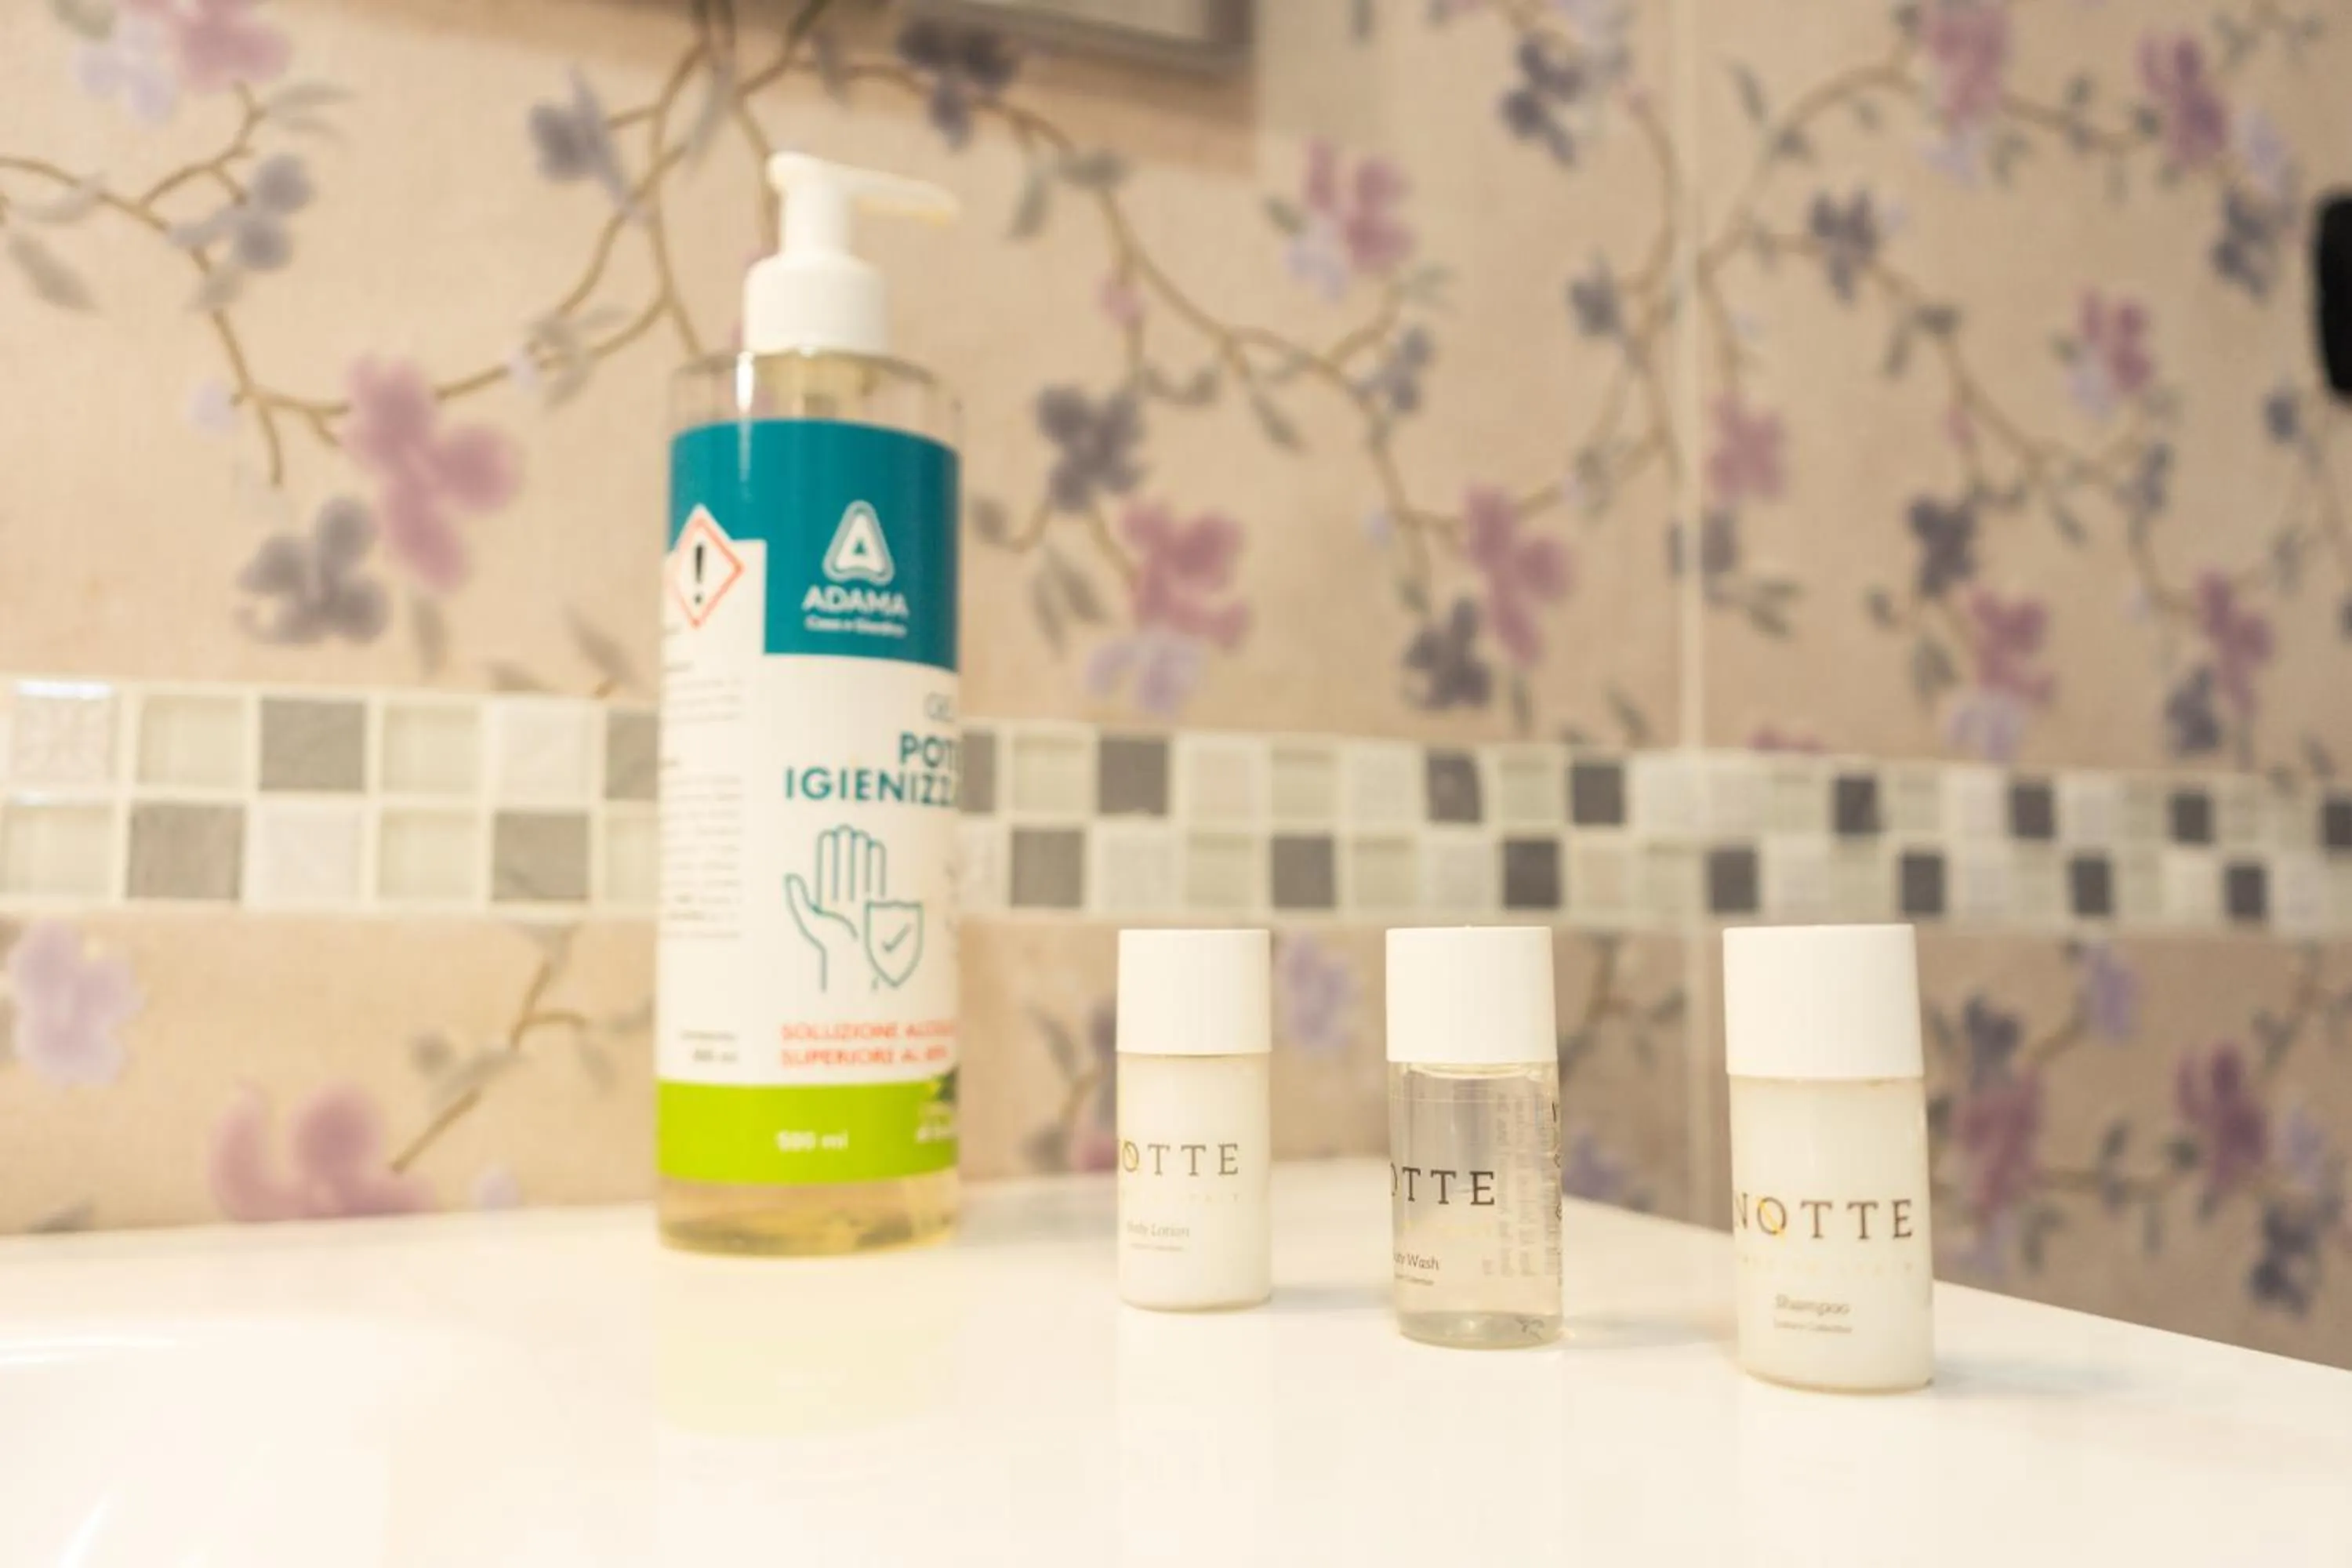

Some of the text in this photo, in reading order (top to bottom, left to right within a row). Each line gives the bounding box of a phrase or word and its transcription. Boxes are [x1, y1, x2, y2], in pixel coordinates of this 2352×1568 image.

[801, 585, 909, 617] ADAMA
[1733, 1191, 1913, 1240] NOTTE
[1406, 1253, 1439, 1271] Wash
[1775, 1294, 1851, 1317] Shampoo
